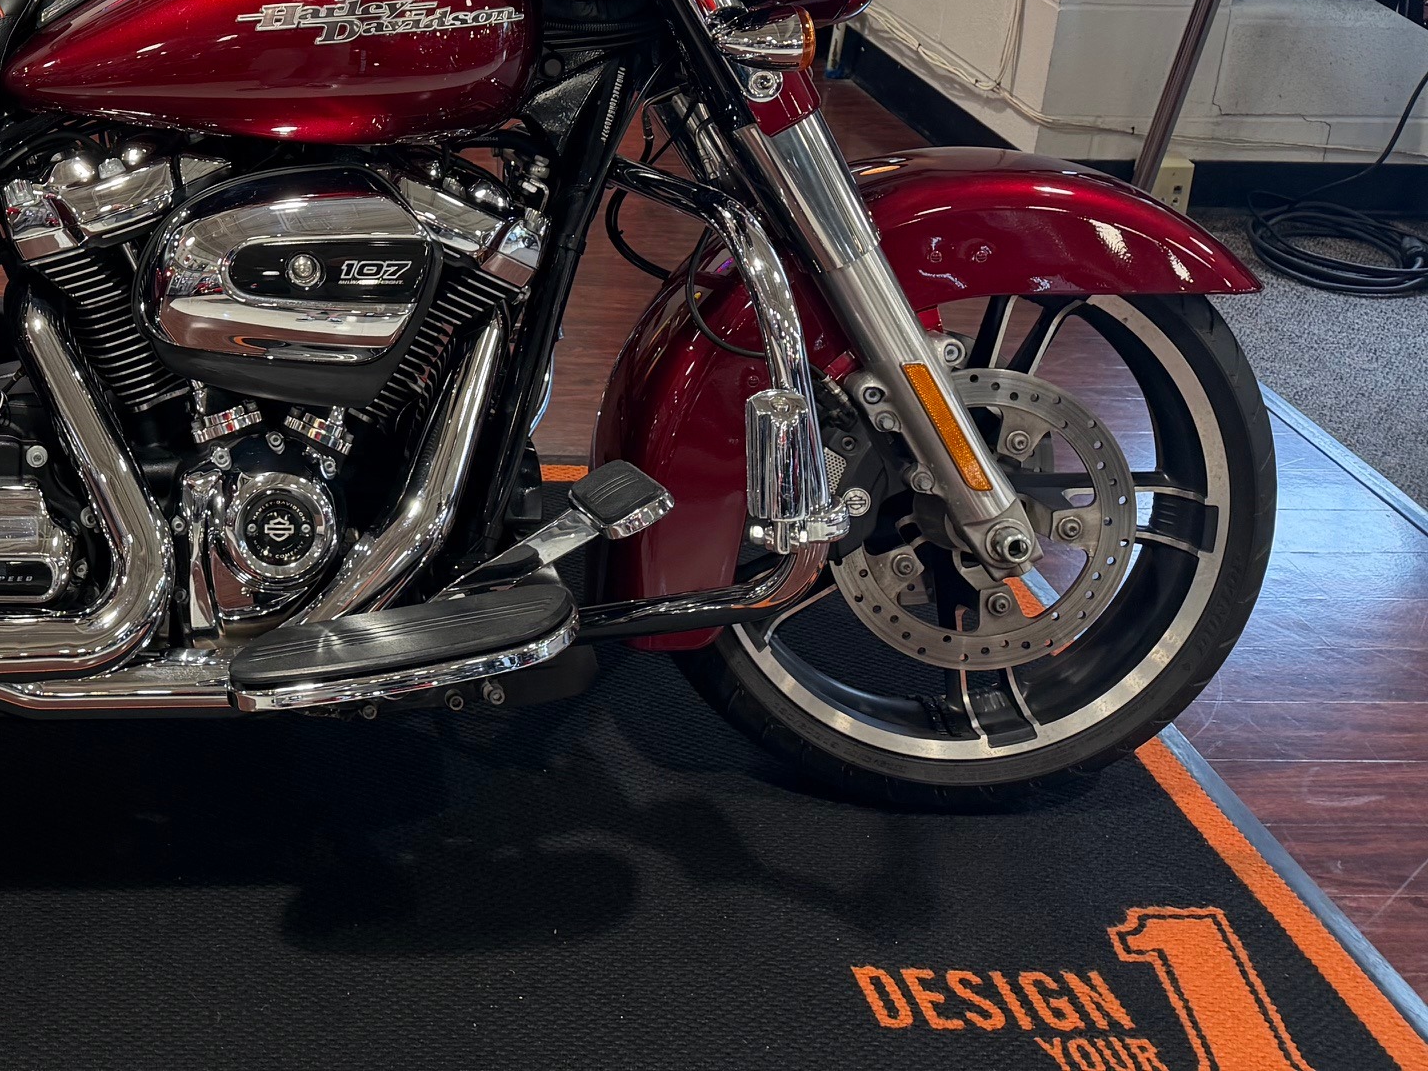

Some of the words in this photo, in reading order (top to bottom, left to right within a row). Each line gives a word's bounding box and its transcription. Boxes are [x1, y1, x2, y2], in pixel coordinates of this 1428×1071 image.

[314, 6, 525, 46] Davidson
[340, 259, 413, 279] 107
[850, 964, 1137, 1031] DESIGN
[1033, 1035, 1171, 1071] YOUR
